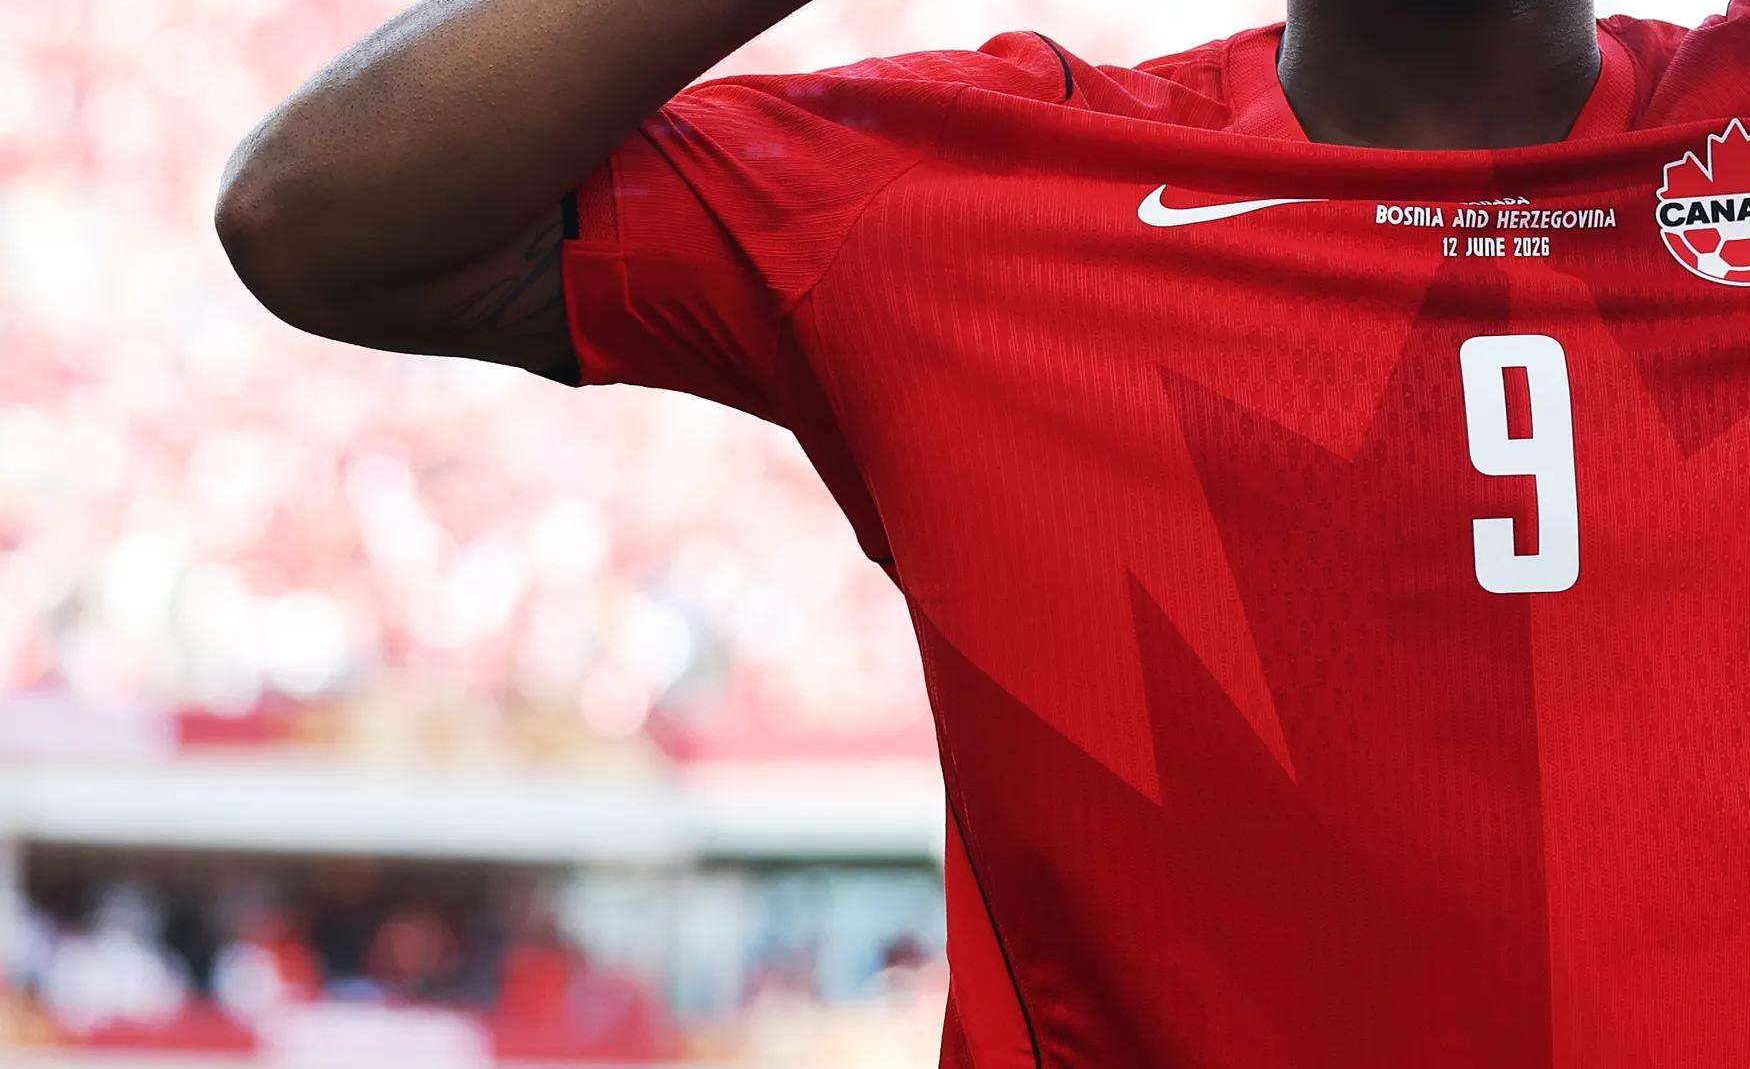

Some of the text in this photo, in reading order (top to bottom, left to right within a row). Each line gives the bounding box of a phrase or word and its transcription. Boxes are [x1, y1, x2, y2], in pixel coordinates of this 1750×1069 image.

[1376, 204, 1616, 229] BOSNIA AND HERZEGOVINA
[1443, 237, 1550, 257] 12 JUNE 2026
[1459, 334, 1580, 594] 9
